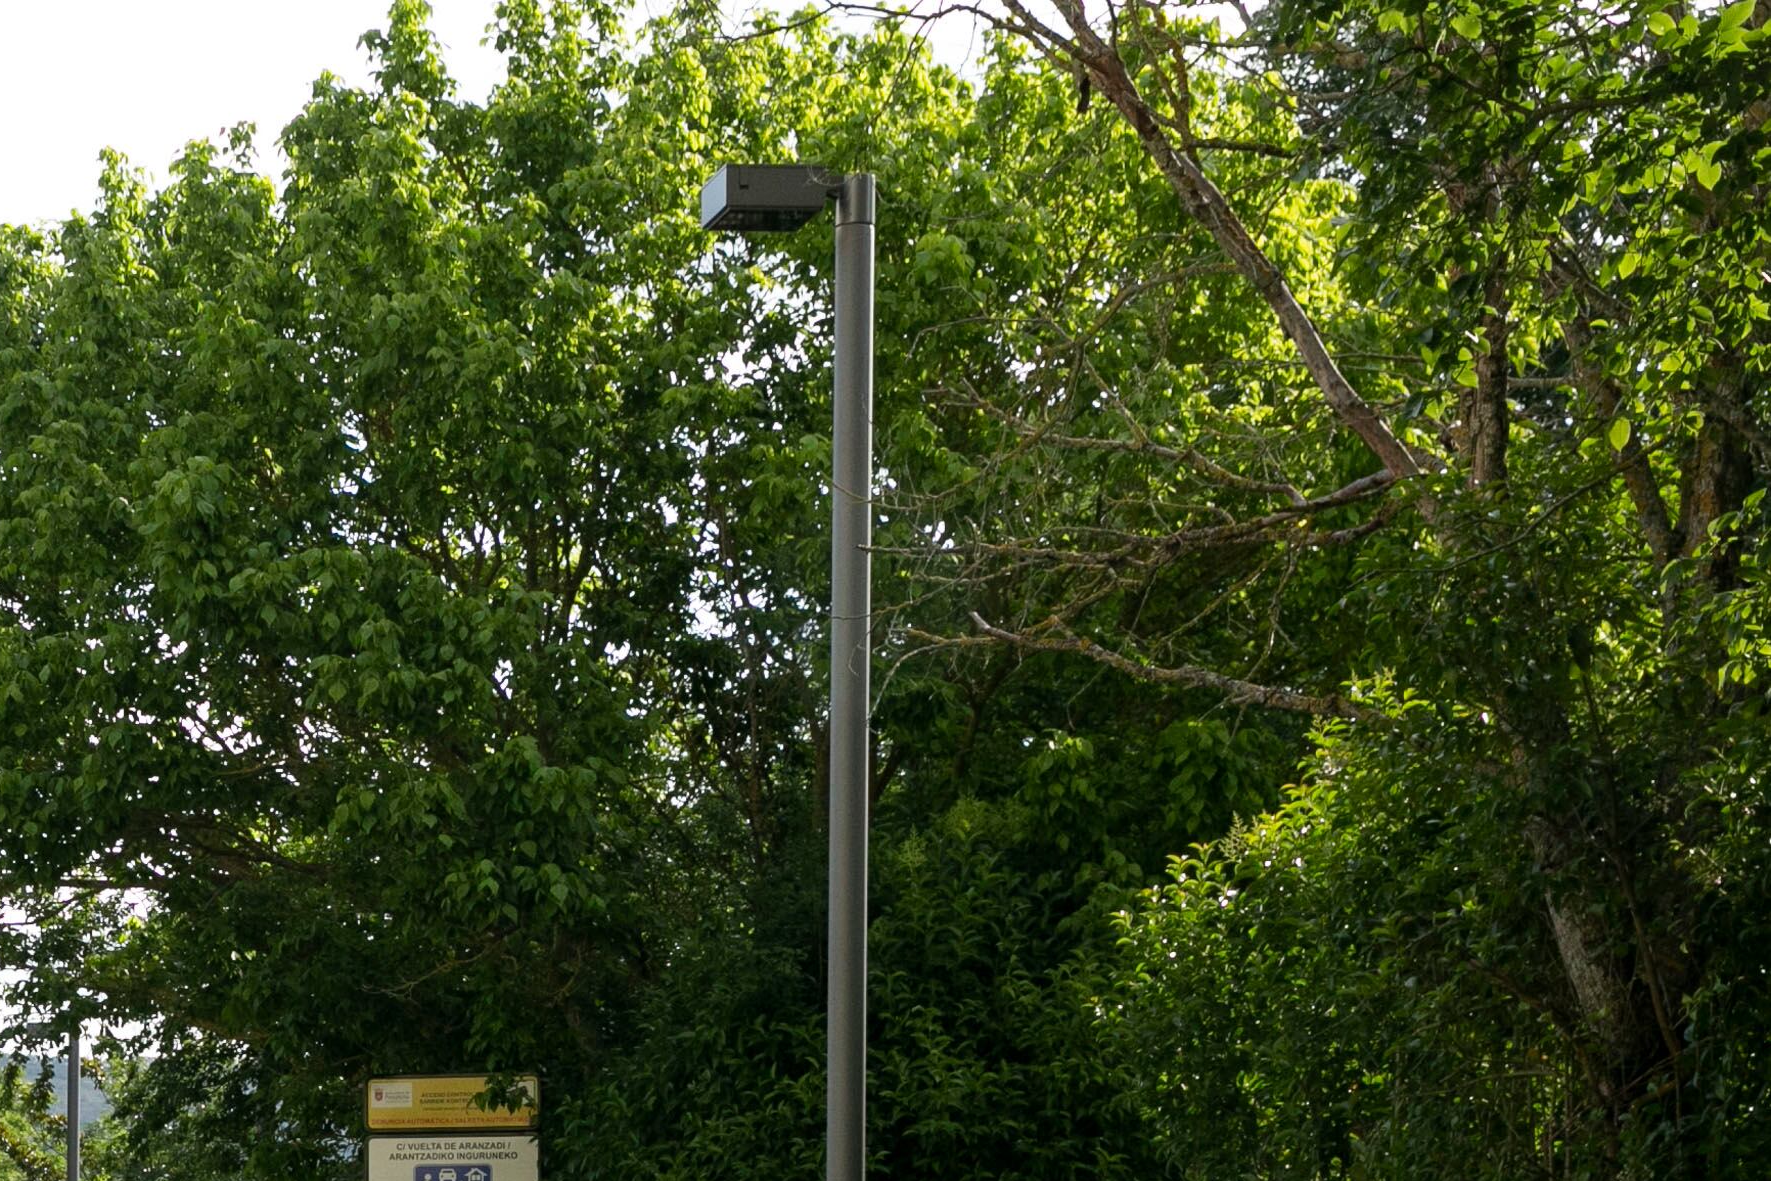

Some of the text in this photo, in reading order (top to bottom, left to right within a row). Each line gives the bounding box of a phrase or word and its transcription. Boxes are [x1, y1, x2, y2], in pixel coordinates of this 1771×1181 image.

[396, 1143, 405, 1151] C/
[408, 1142, 442, 1151] VUELTA
[444, 1142, 457, 1150] DE
[459, 1142, 505, 1150] ARANZADI
[389, 1151, 518, 1161] ARANTZADIKO INGURUNEKO
